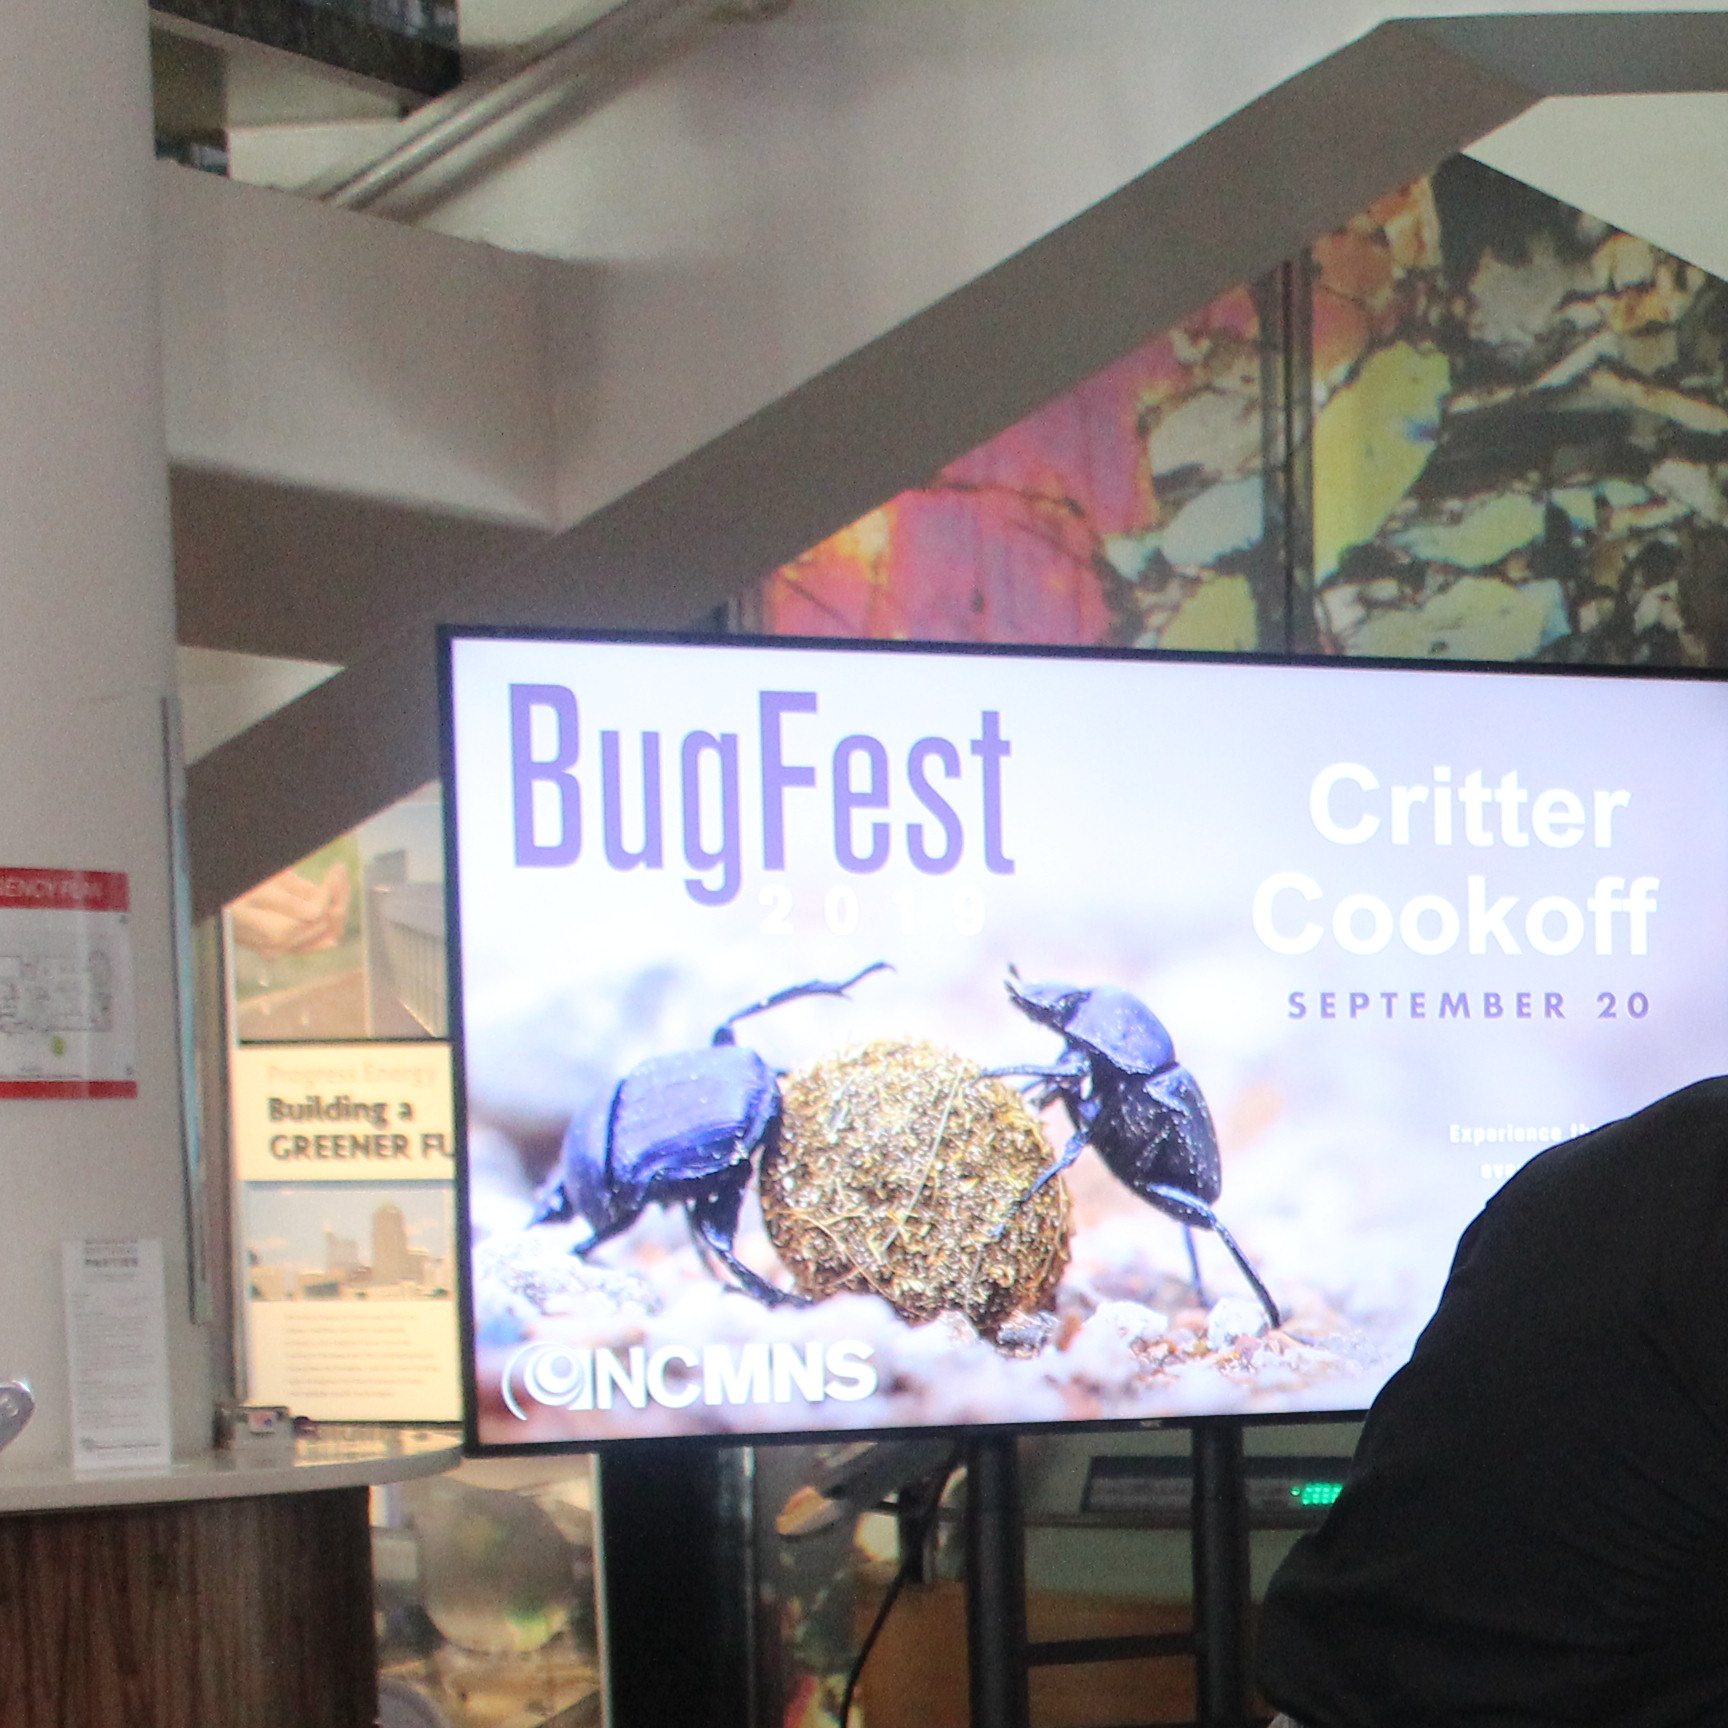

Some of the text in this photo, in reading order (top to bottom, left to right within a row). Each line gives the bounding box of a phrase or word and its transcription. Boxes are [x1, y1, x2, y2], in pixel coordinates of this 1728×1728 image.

[508, 682, 1016, 908] BugFest
[1309, 761, 1632, 849] Critter
[758, 884, 988, 937] 2019
[1251, 870, 1661, 956] Cookoff
[1287, 991, 1651, 1020] SEPTEMBER 20
[267, 1095, 413, 1129] Building a
[269, 1134, 411, 1160] GREENER
[1449, 1123, 1563, 1147] Experience
